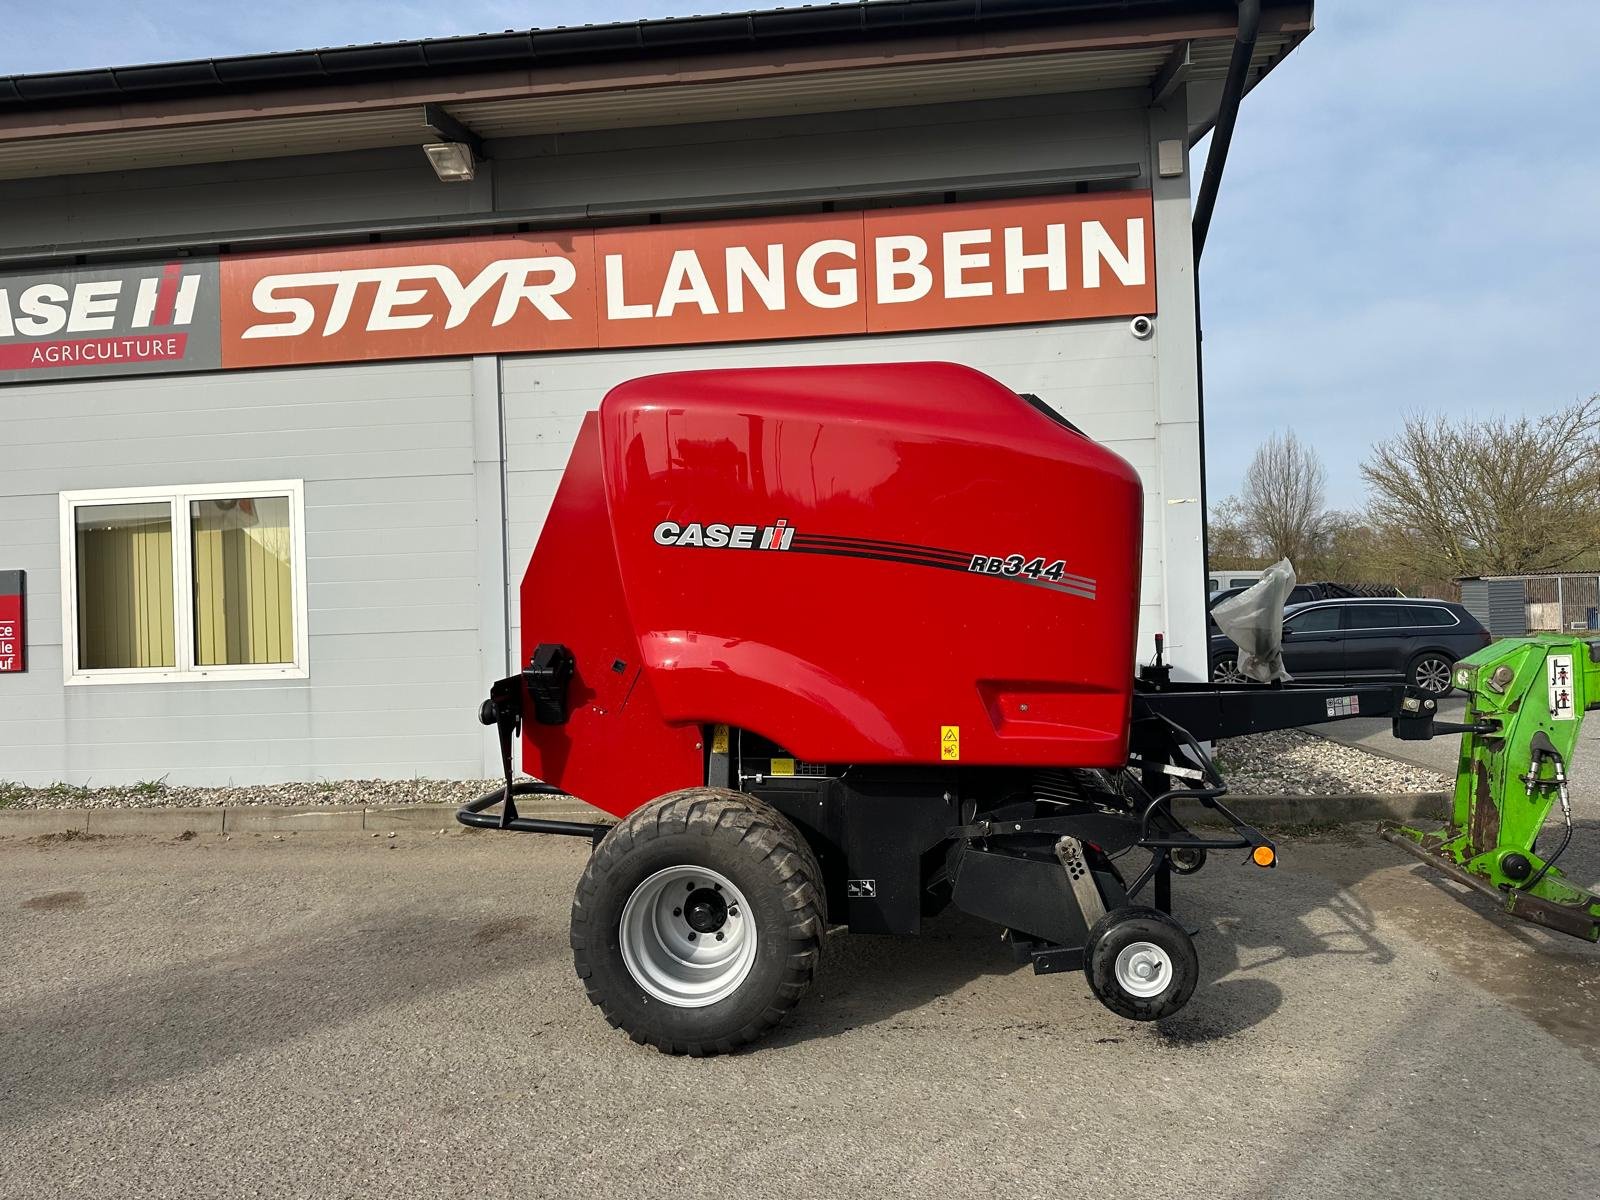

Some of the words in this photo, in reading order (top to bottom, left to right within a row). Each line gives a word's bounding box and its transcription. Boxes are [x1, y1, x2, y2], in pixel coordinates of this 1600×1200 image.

[605, 217, 1147, 320] LANGBEHN
[241, 256, 577, 339] STEYR
[31, 338, 178, 363] AGRICULTURE
[653, 521, 757, 549] CASE
[968, 553, 1067, 582] RB344
